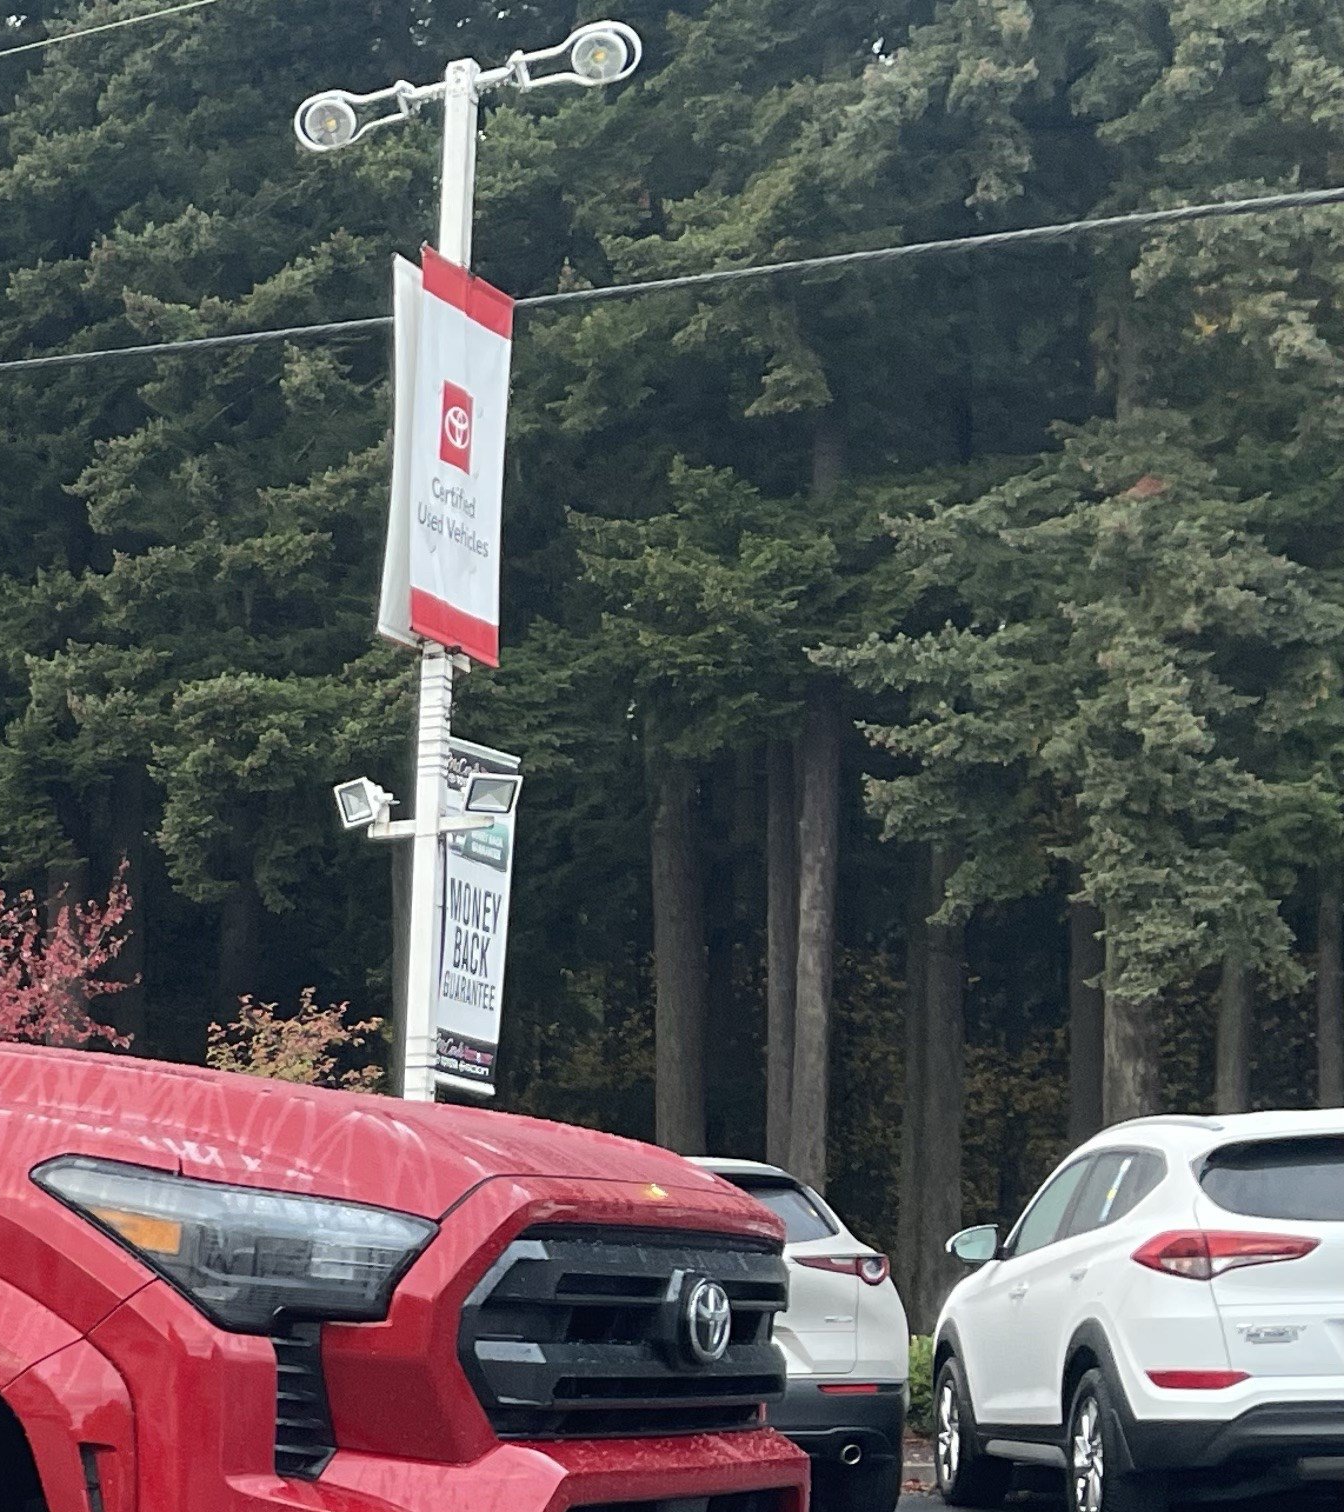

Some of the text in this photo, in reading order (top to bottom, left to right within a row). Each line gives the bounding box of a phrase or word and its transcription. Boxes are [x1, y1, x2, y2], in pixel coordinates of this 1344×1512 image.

[432, 476, 476, 520] Certified
[418, 501, 490, 558] Used Vehicles
[450, 877, 502, 935] MONEY
[453, 925, 491, 979] BACK
[443, 970, 496, 1012] GUARANTEE
